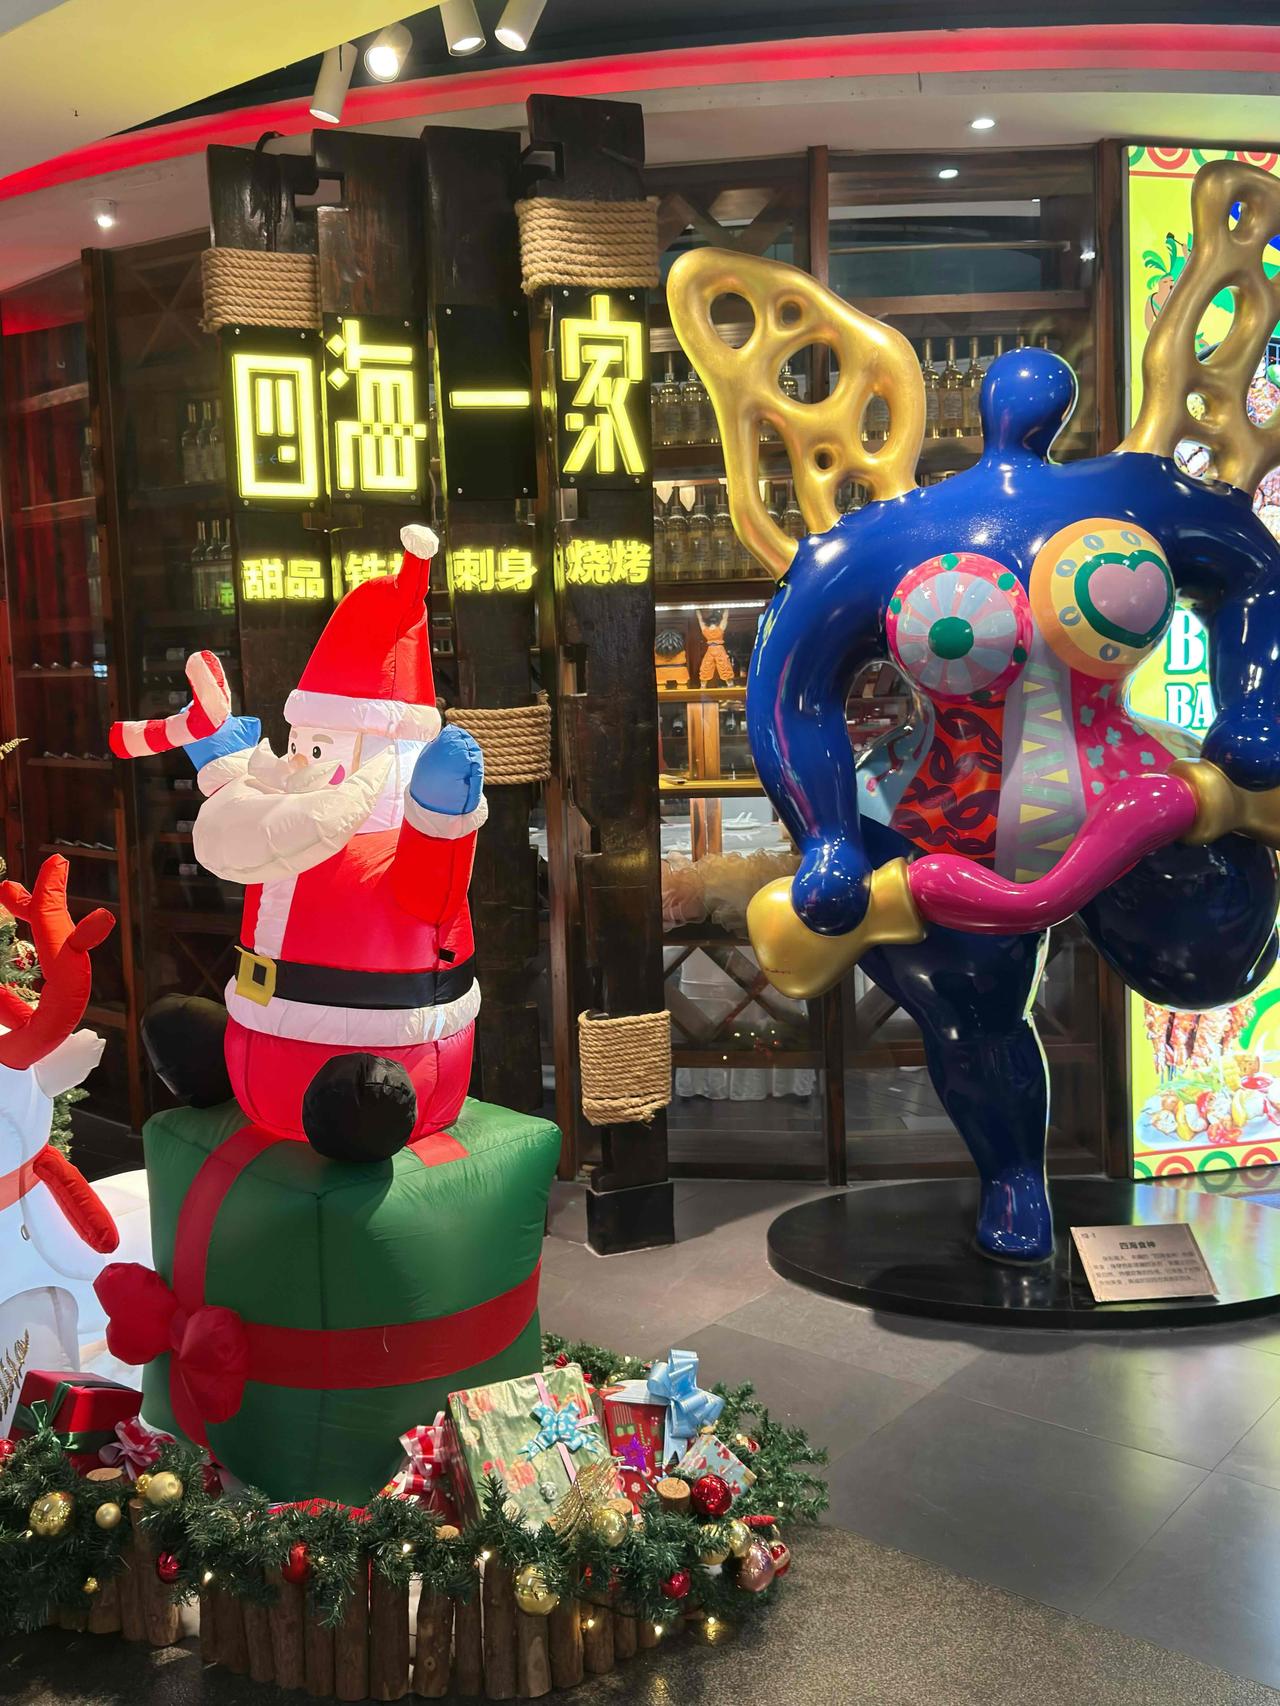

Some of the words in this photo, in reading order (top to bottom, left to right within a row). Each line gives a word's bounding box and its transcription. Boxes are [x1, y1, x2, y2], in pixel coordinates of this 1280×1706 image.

[241, 558, 325, 600] 甜品
[345, 553, 403, 589] 铁
[453, 548, 538, 591] 刺身
[566, 540, 652, 584] 烧烤
